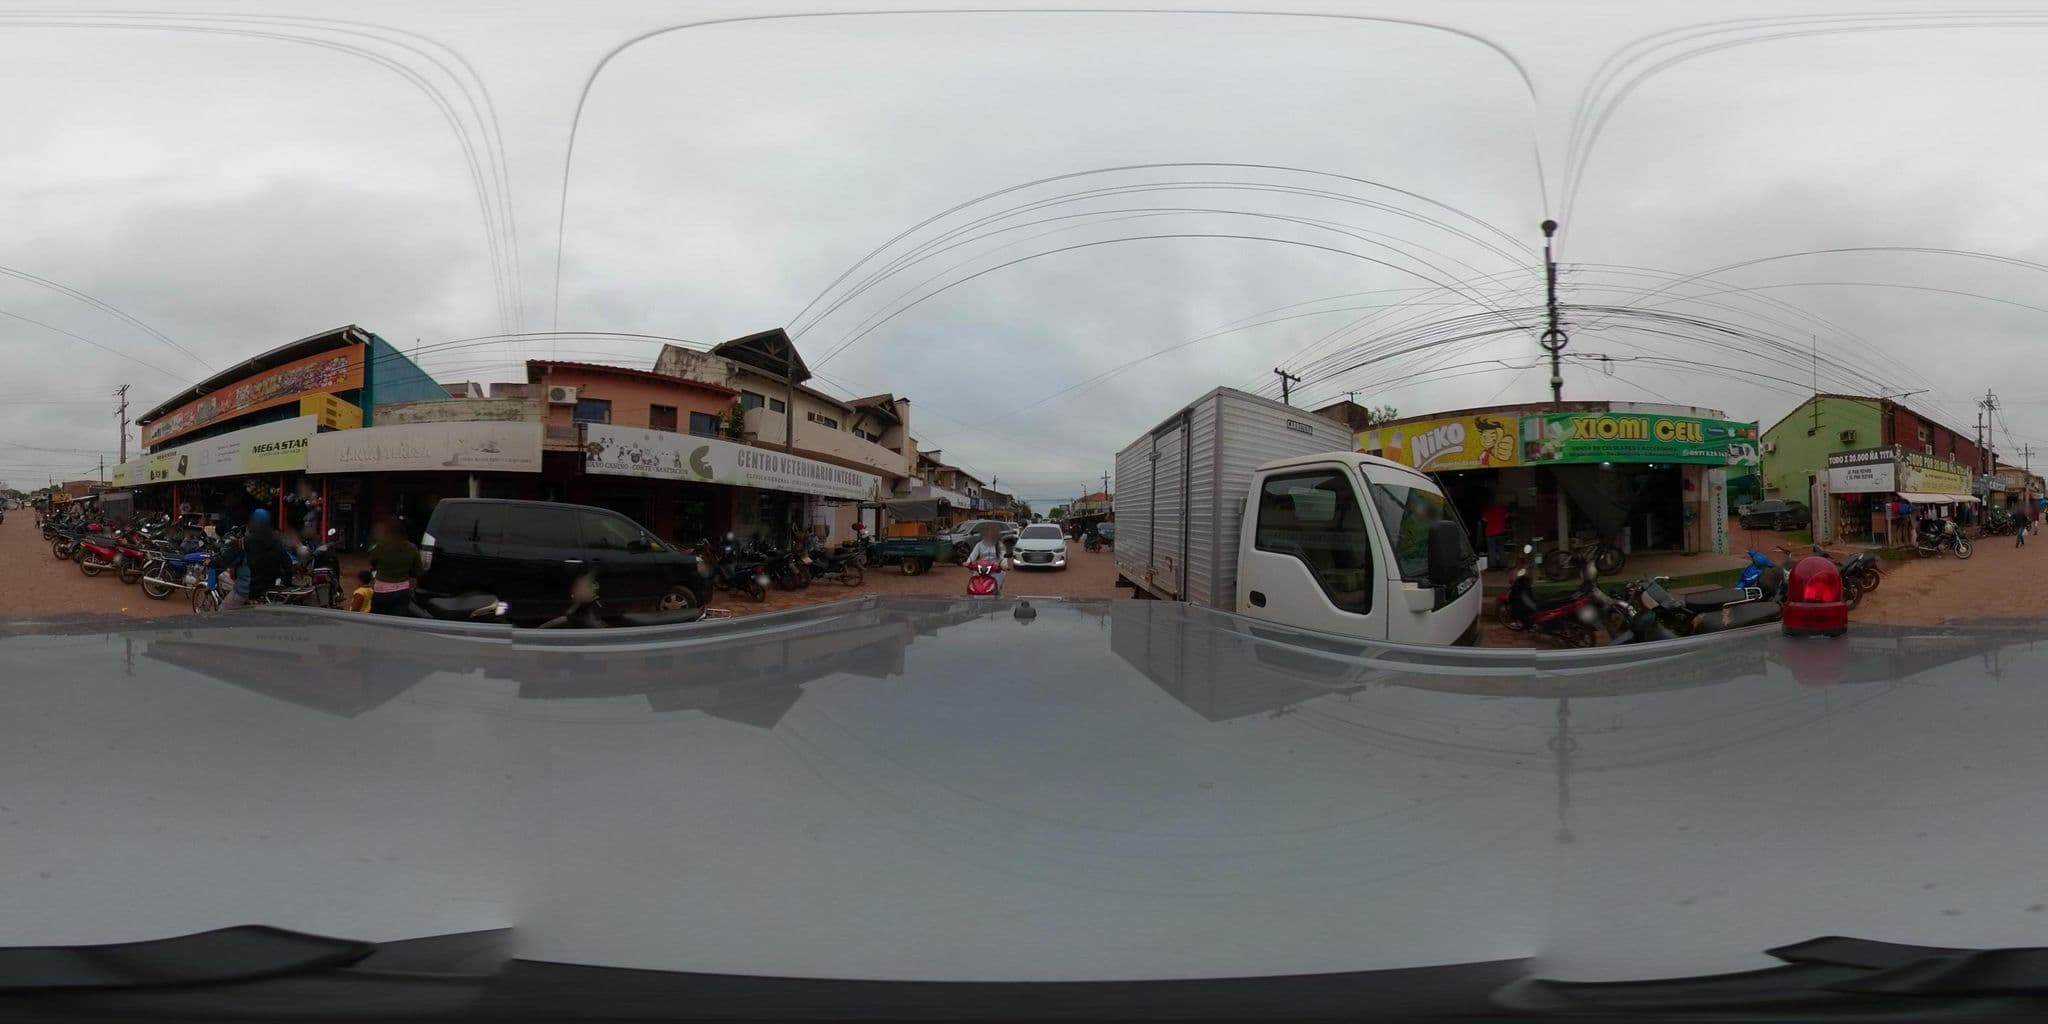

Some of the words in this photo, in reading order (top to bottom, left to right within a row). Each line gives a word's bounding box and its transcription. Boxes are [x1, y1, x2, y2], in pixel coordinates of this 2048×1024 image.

[1572, 417, 1650, 442] XIOMI
[1654, 418, 1704, 443] CELL
[737, 448, 778, 473] CENTRO
[780, 457, 833, 483] VETERINARIO
[834, 470, 863, 488] INTEGRAL
[1880, 450, 1894, 460] TITA
